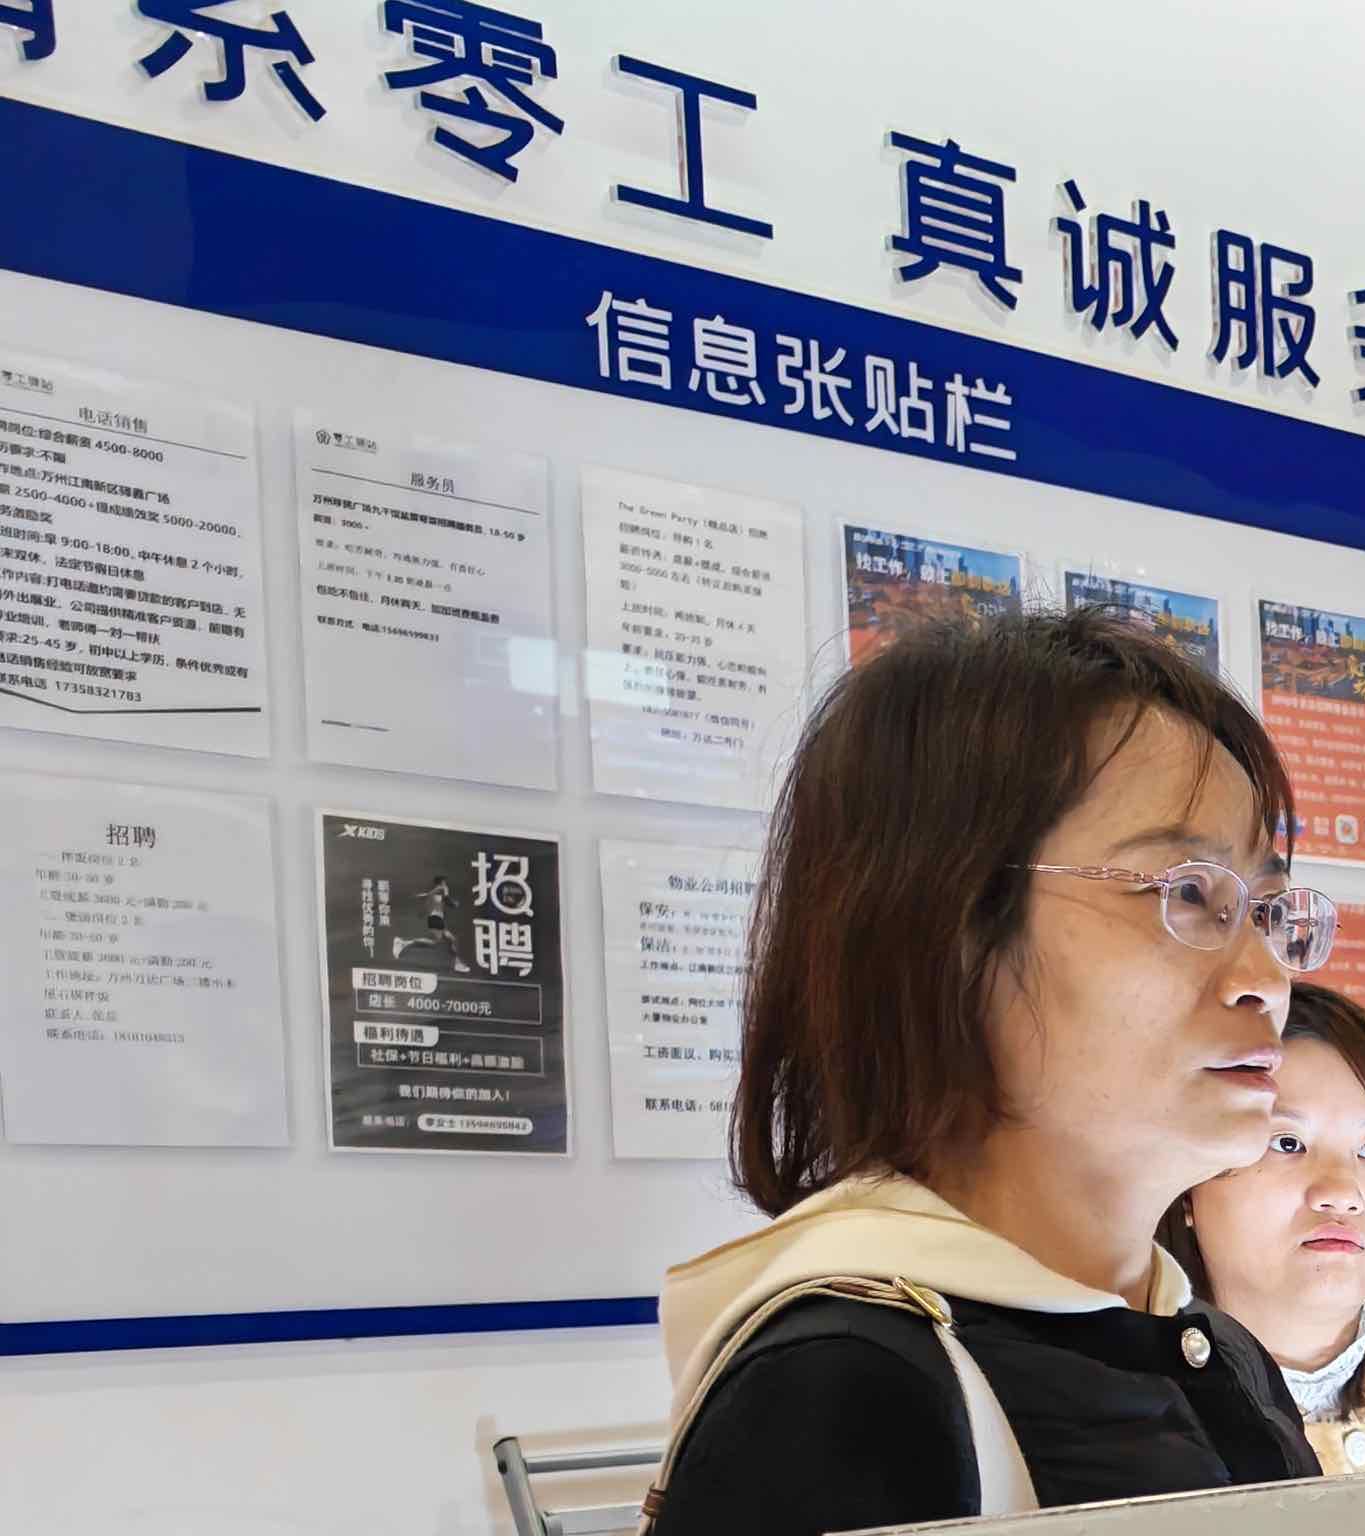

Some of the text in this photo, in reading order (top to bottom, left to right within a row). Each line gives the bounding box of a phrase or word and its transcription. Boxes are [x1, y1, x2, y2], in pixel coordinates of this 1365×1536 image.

[586, 290, 1017, 462] 信息张贴栏
[95, 441, 163, 463] 4500-8000
[410, 471, 455, 494] 服务员
[106, 824, 157, 849] 招聘
